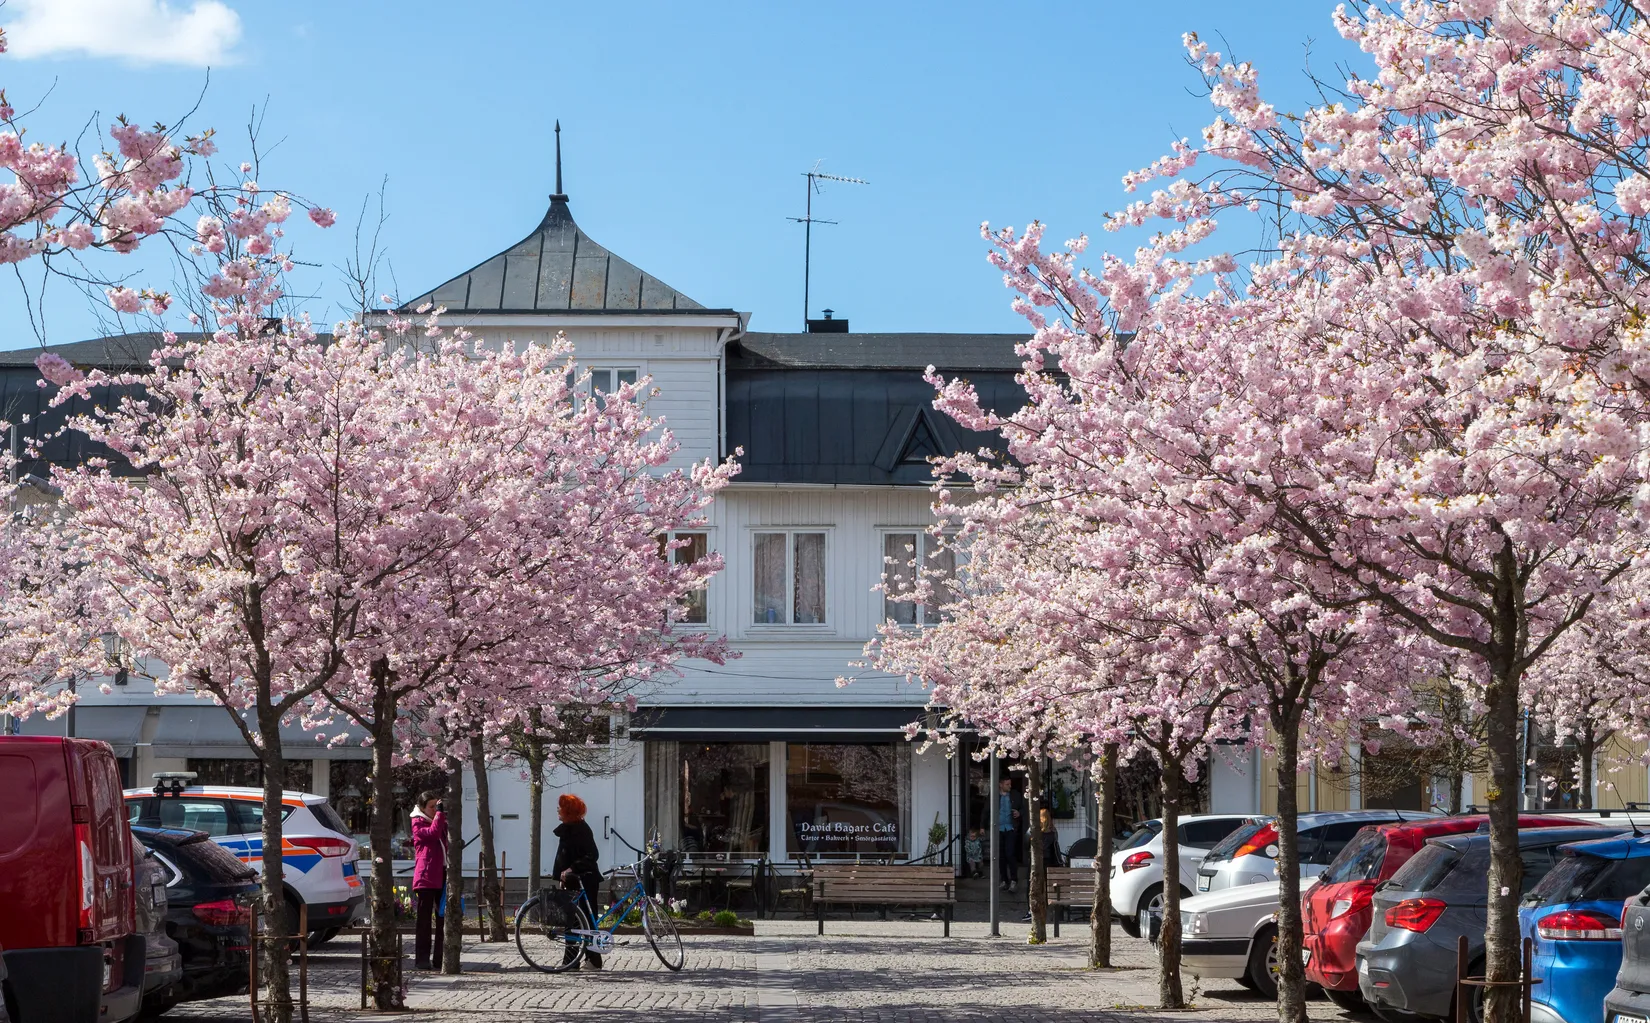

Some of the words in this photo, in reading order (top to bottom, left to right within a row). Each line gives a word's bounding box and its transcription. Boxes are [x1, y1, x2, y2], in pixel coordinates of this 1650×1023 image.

[801, 822, 832, 832] David
[834, 822, 870, 834] Bagare
[872, 822, 896, 833] Café
[825, 834, 850, 842] Bakverk
